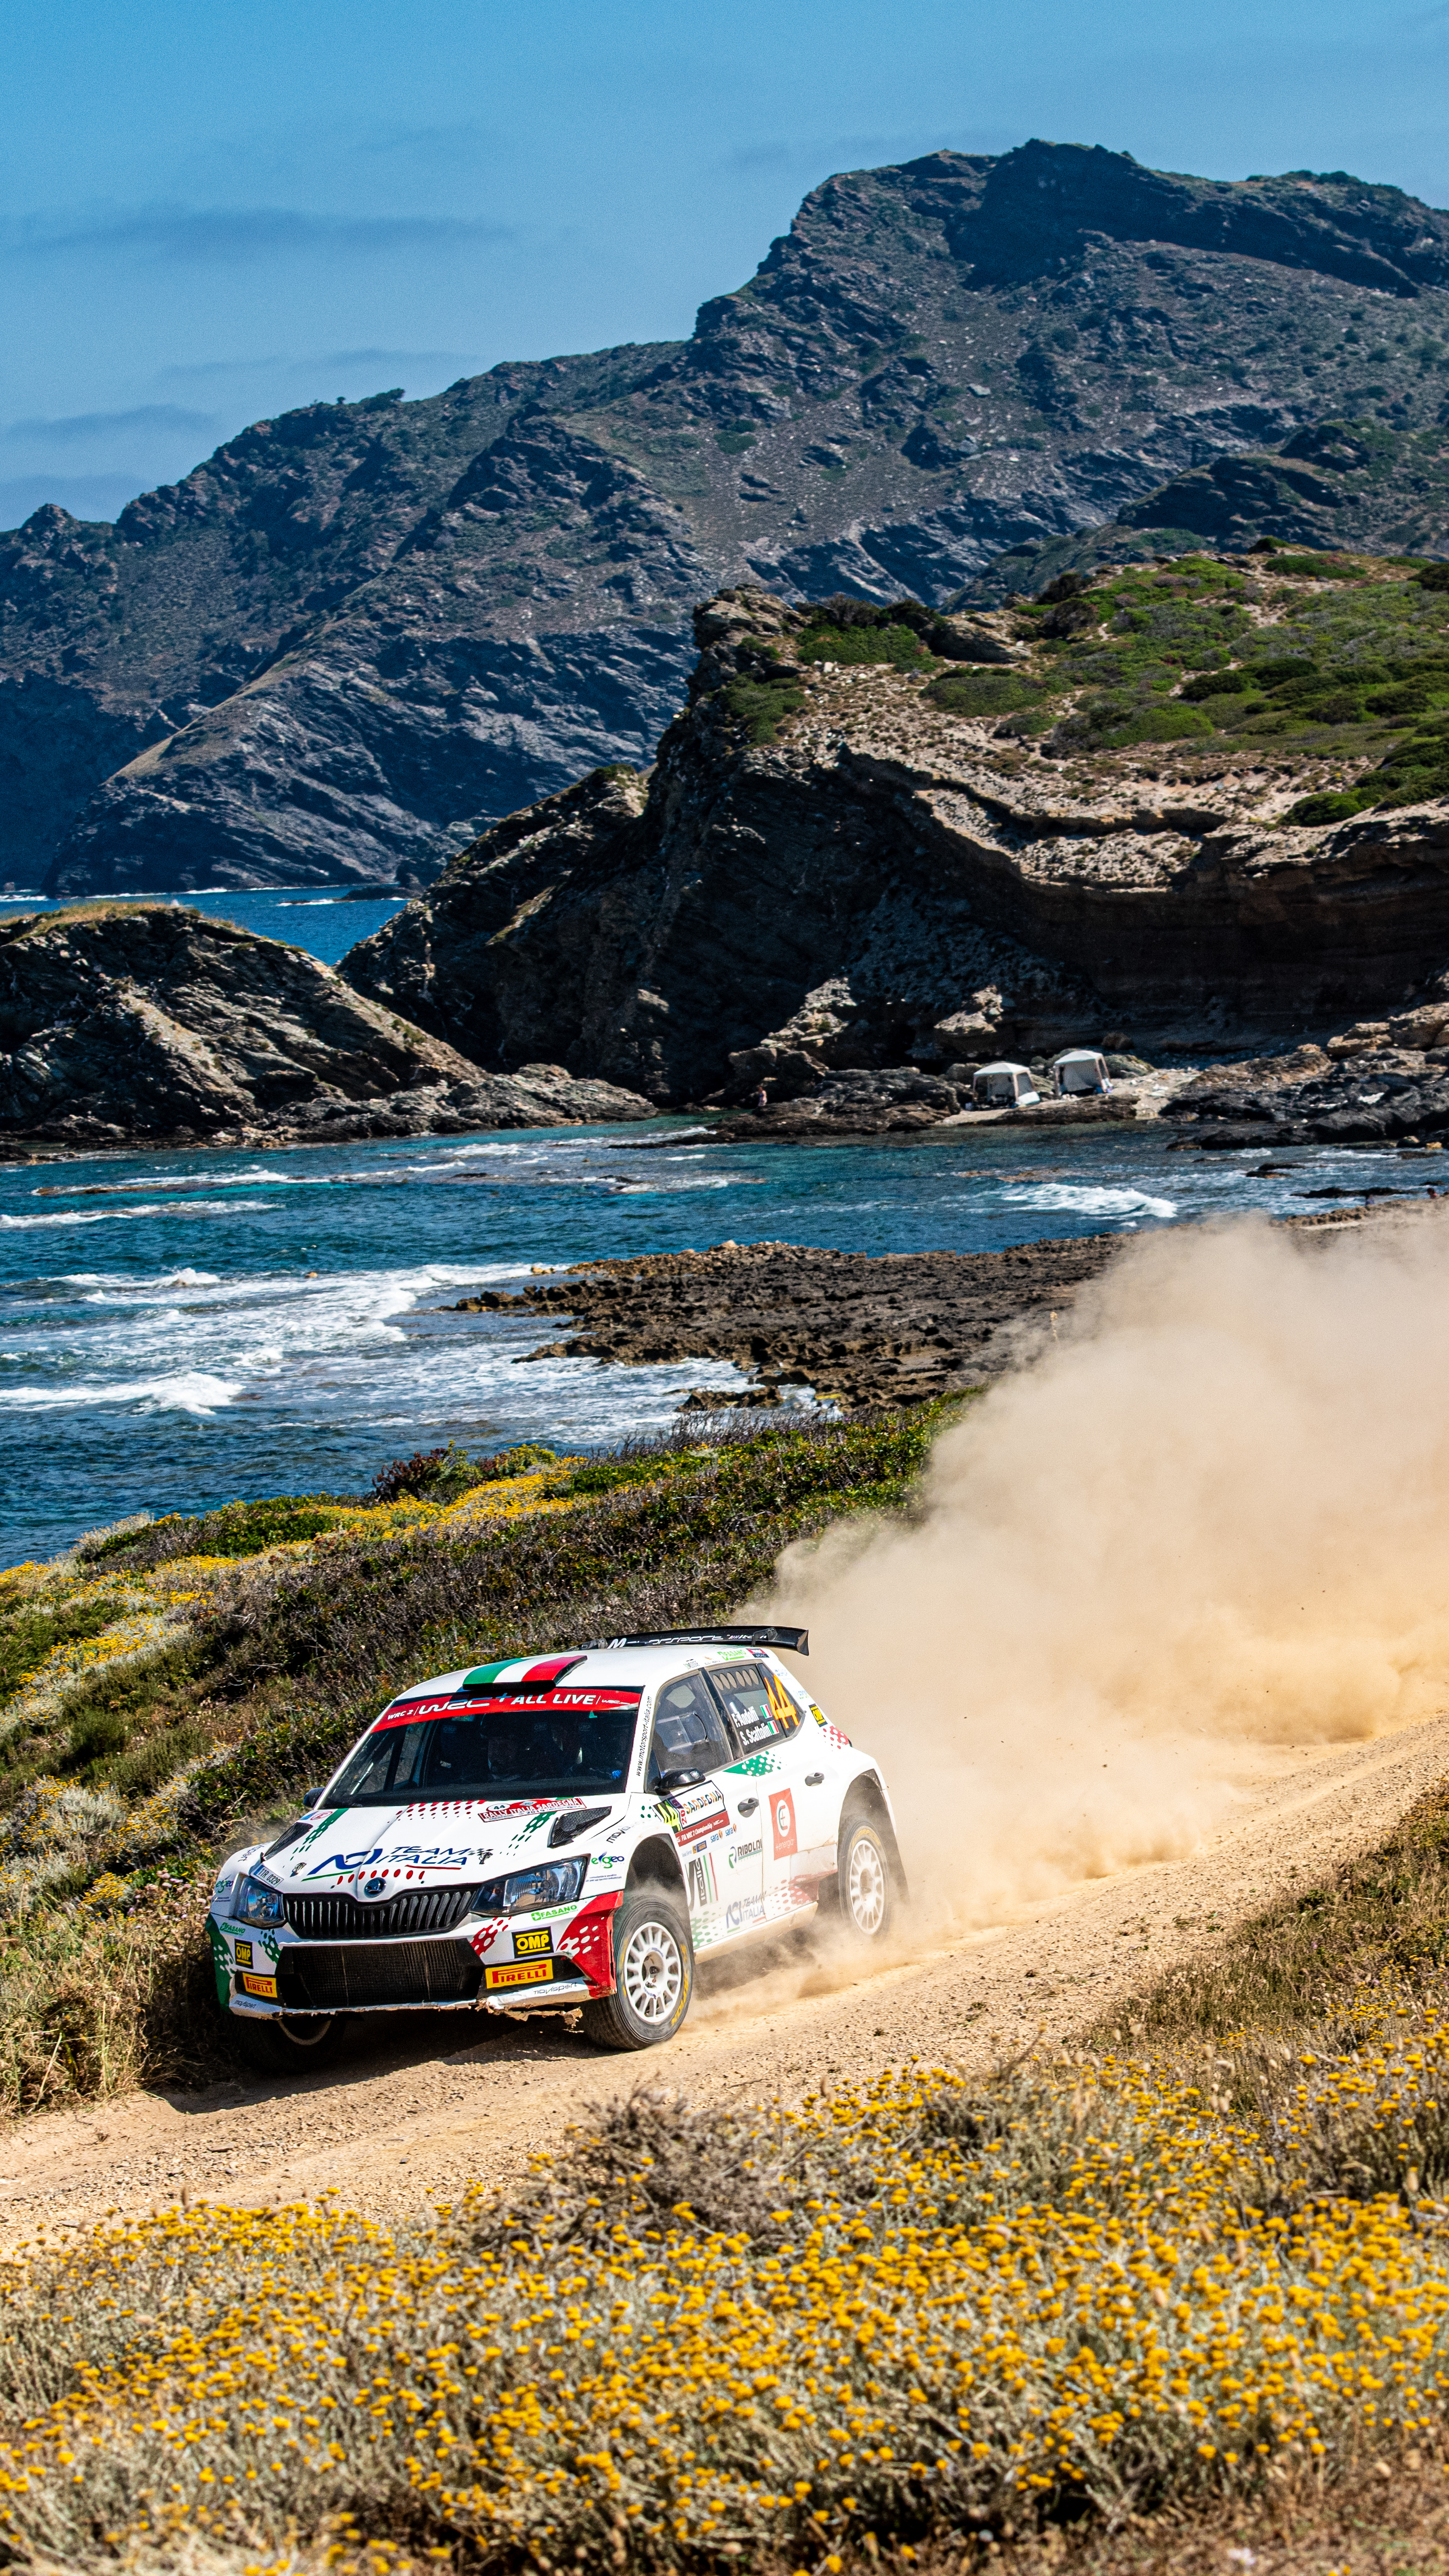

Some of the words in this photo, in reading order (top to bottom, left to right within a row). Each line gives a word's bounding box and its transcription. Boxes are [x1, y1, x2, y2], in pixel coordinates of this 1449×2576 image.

[725, 1649, 746, 1658] FASANO
[510, 1695, 546, 1705] ALL
[552, 1694, 596, 1705] LIVE
[765, 1674, 799, 1729] 44
[387, 1711, 406, 1720] WRC
[731, 1713, 740, 1728] F.
[636, 1696, 652, 1776] www.motorsport-italia.com
[739, 1731, 749, 1746] S.
[483, 1808, 508, 1819] RALLY
[509, 1806, 537, 1815] ITALIA
[536, 1798, 580, 1811] SARDEGNA
[683, 1790, 722, 1815] SARDEGNA
[657, 1800, 681, 1831] 44
[710, 1833, 719, 1843] sara
[725, 1828, 734, 1837] sara
[390, 1846, 472, 1855] TEAM
[375, 1854, 467, 1865] ITALIA
[258, 1868, 269, 1878] 11R
[266, 1874, 281, 1885] 0329
[743, 1893, 762, 1909] TEAM
[541, 1905, 577, 1918] FASANO
[743, 1905, 764, 1921] ITALIA
[226, 1924, 246, 1934] FASANO
[516, 1934, 549, 1951] OMP
[236, 1946, 251, 1961] OMP
[492, 1964, 547, 1984] PIRELLI
[245, 1976, 273, 1993] PIRELLI
